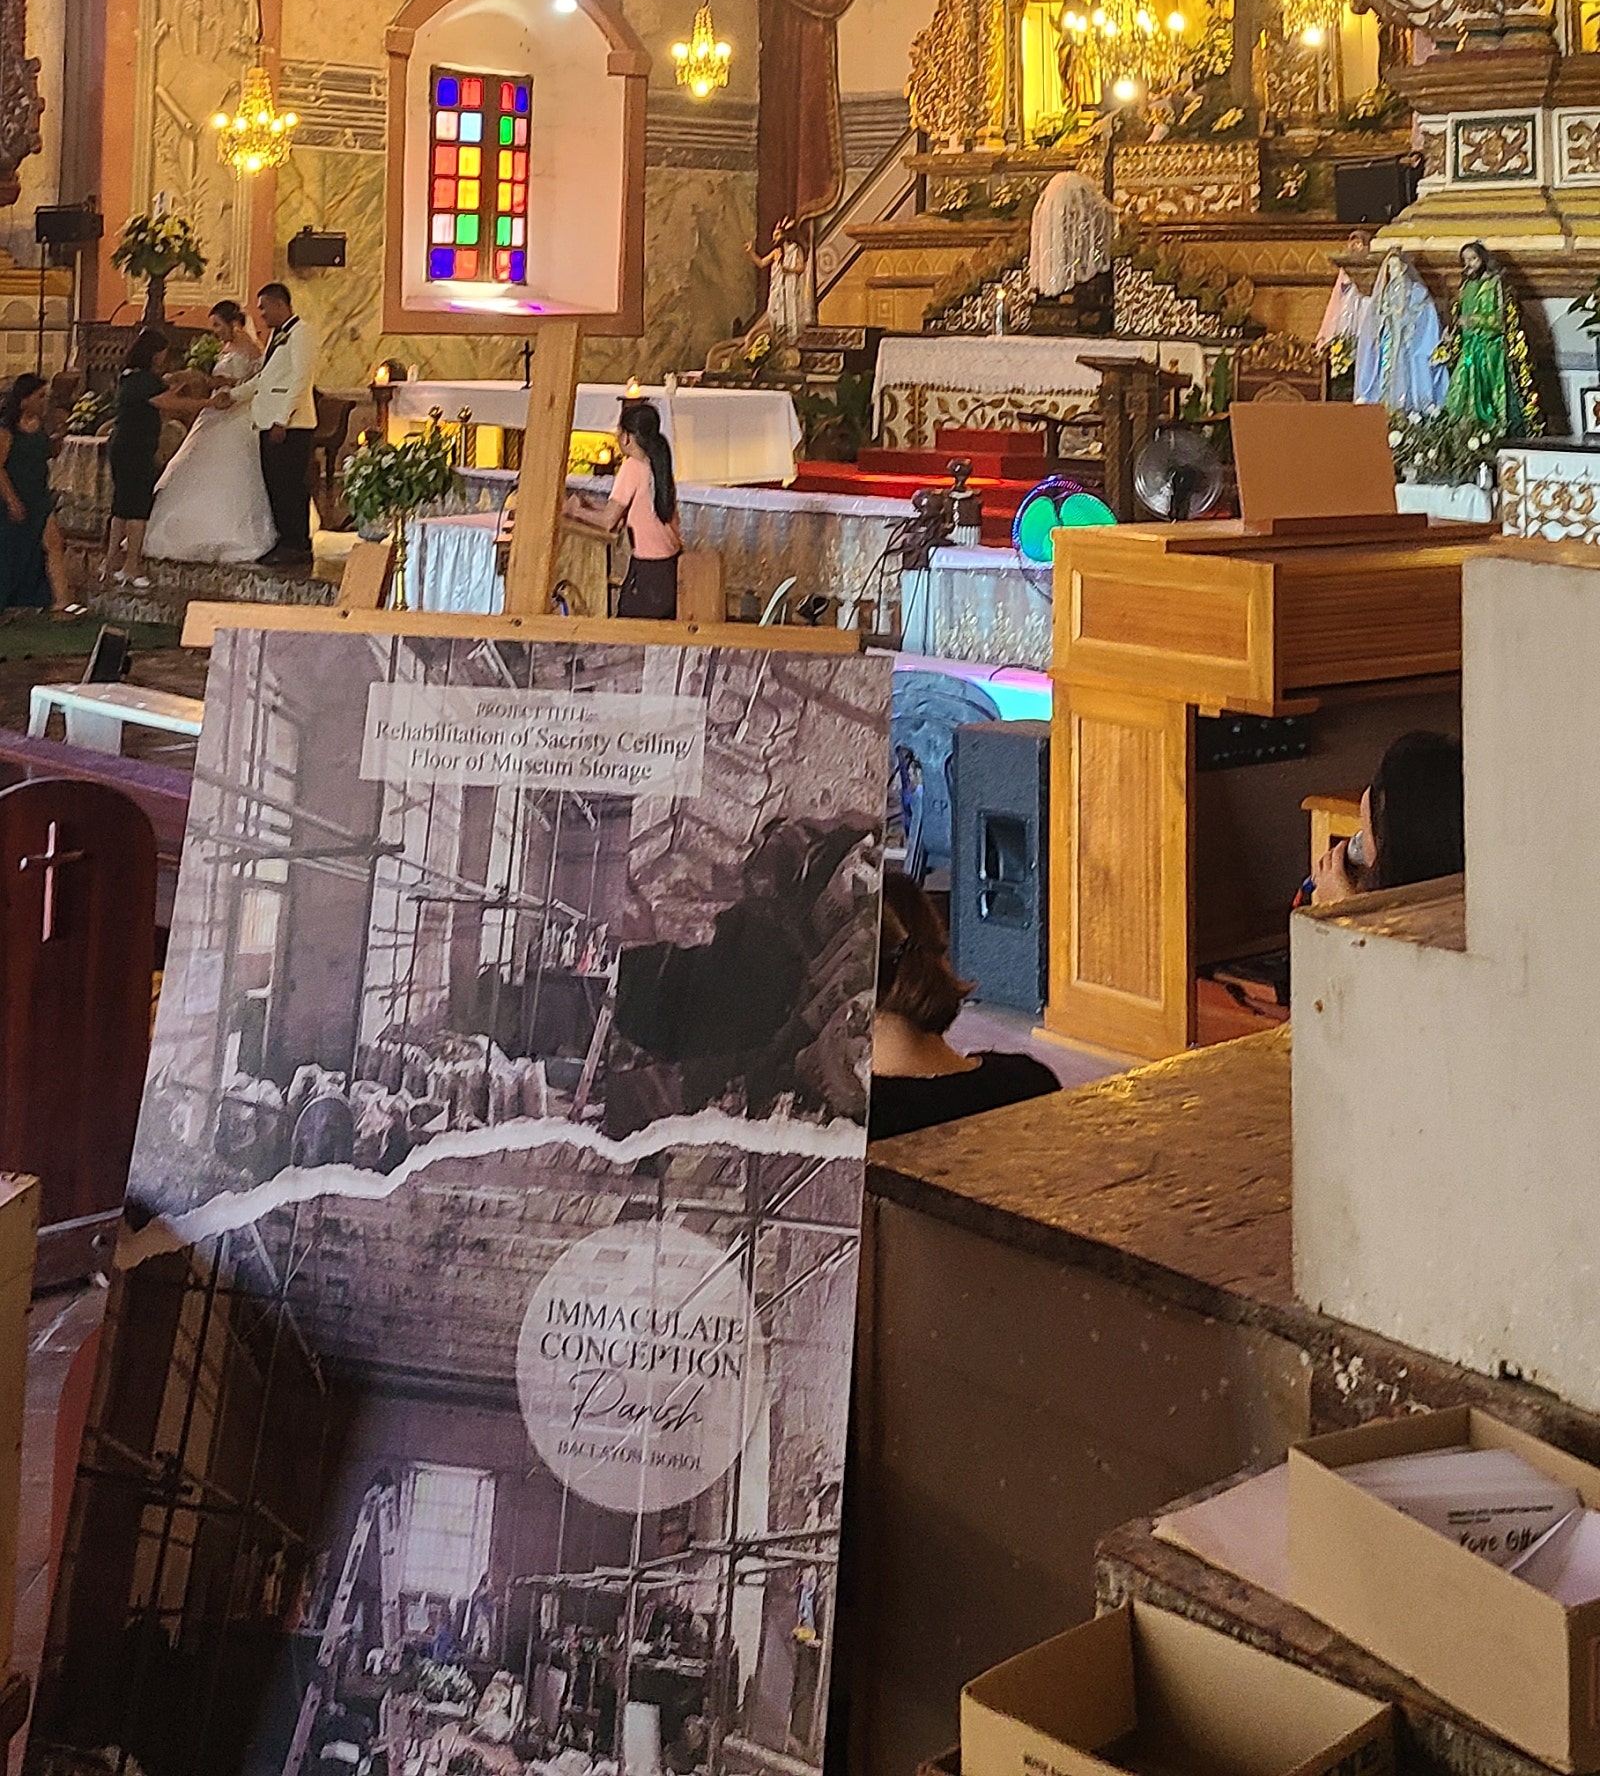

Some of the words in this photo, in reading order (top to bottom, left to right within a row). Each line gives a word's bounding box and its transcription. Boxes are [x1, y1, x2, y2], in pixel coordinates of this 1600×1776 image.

[376, 720, 505, 745] Rehabilitation
[511, 726, 535, 747] of
[536, 727, 611, 756] Sacristy
[617, 731, 697, 761] Ceiling/
[411, 748, 461, 770] Floor
[466, 751, 489, 771] of
[491, 752, 573, 776] Museum
[579, 756, 652, 785] Storage
[545, 1298, 745, 1344] IMMACULATE
[540, 1331, 744, 1380] CONCEPTION
[568, 1366, 703, 1433] Parish
